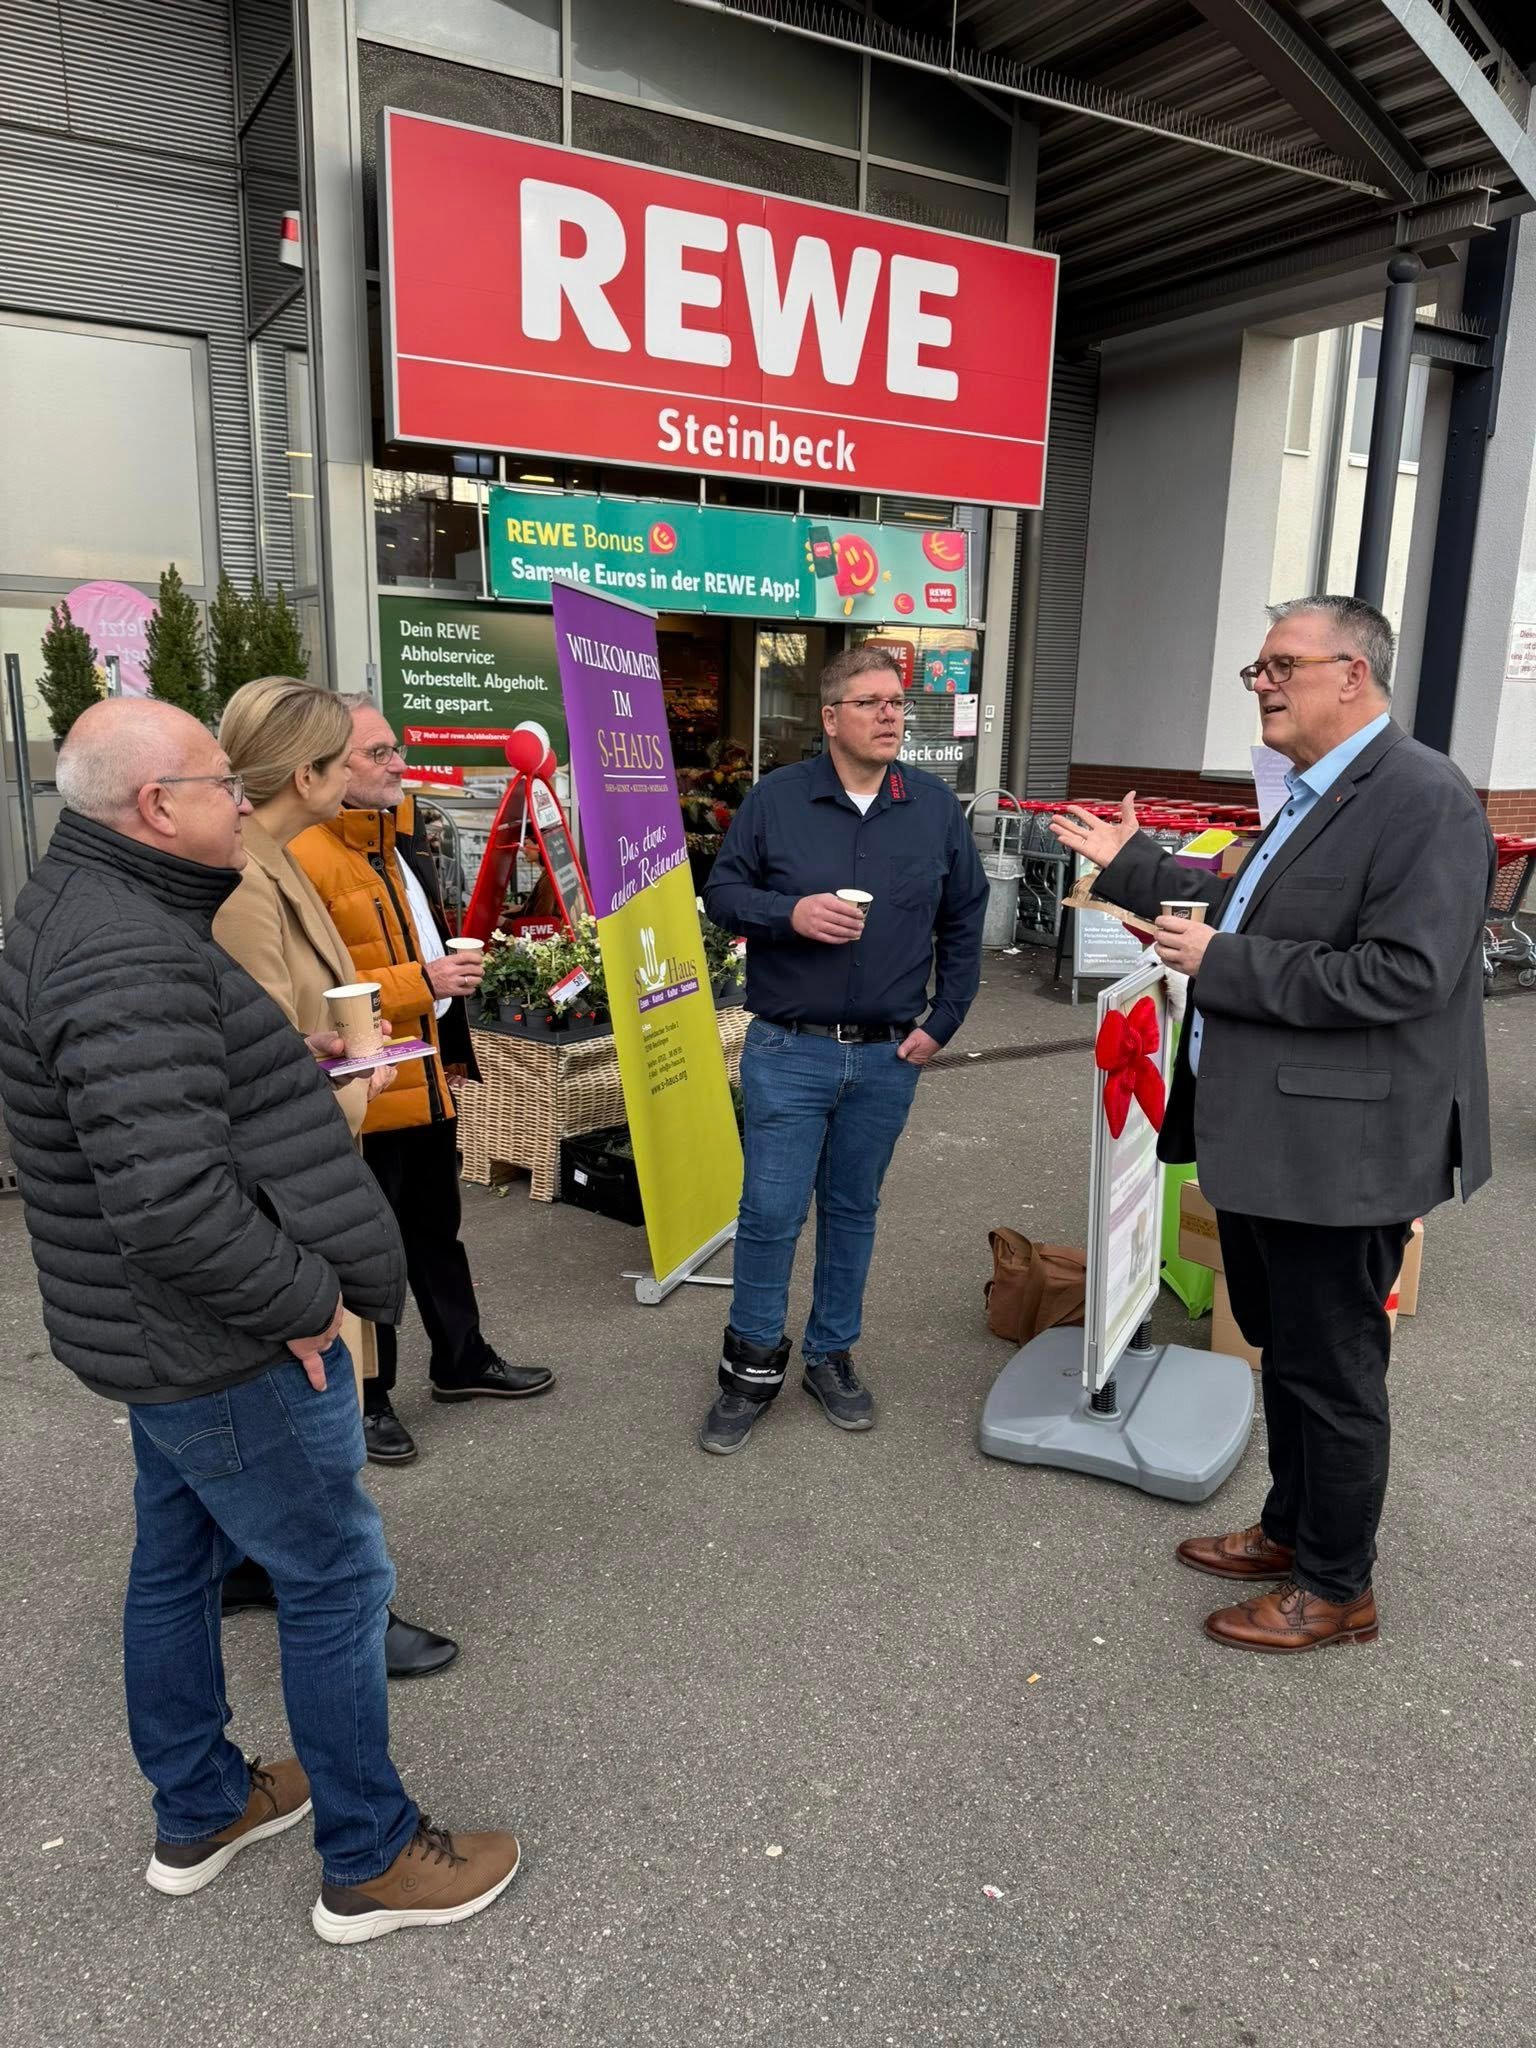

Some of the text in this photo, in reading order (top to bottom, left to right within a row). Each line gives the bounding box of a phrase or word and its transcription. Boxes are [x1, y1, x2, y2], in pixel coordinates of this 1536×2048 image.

[519, 177, 960, 402] REWE
[657, 406, 856, 473] Steinbeck
[506, 517, 644, 553] REWE Bonus
[511, 557, 800, 603] Sammle Euros in der REWE App!
[929, 588, 952, 597] REWE
[400, 620, 481, 640] Dein REWE
[401, 645, 495, 665] Abholservice:
[566, 633, 660, 680] WILLKOMMEN
[401, 669, 548, 693] Vorbestellt. Abgeholt.
[403, 693, 493, 715] Zeit gespart.
[612, 690, 633, 717] IM
[597, 729, 664, 770] S-HAUS
[936, 746, 963, 761] oHG
[618, 825, 667, 867] Das etwas
[611, 867, 638, 911] andere
[638, 836, 688, 889] Restaurant
[520, 924, 554, 936] REWE
[666, 957, 697, 983] Haus
[651, 1070, 688, 1095] www.s-haus.org
